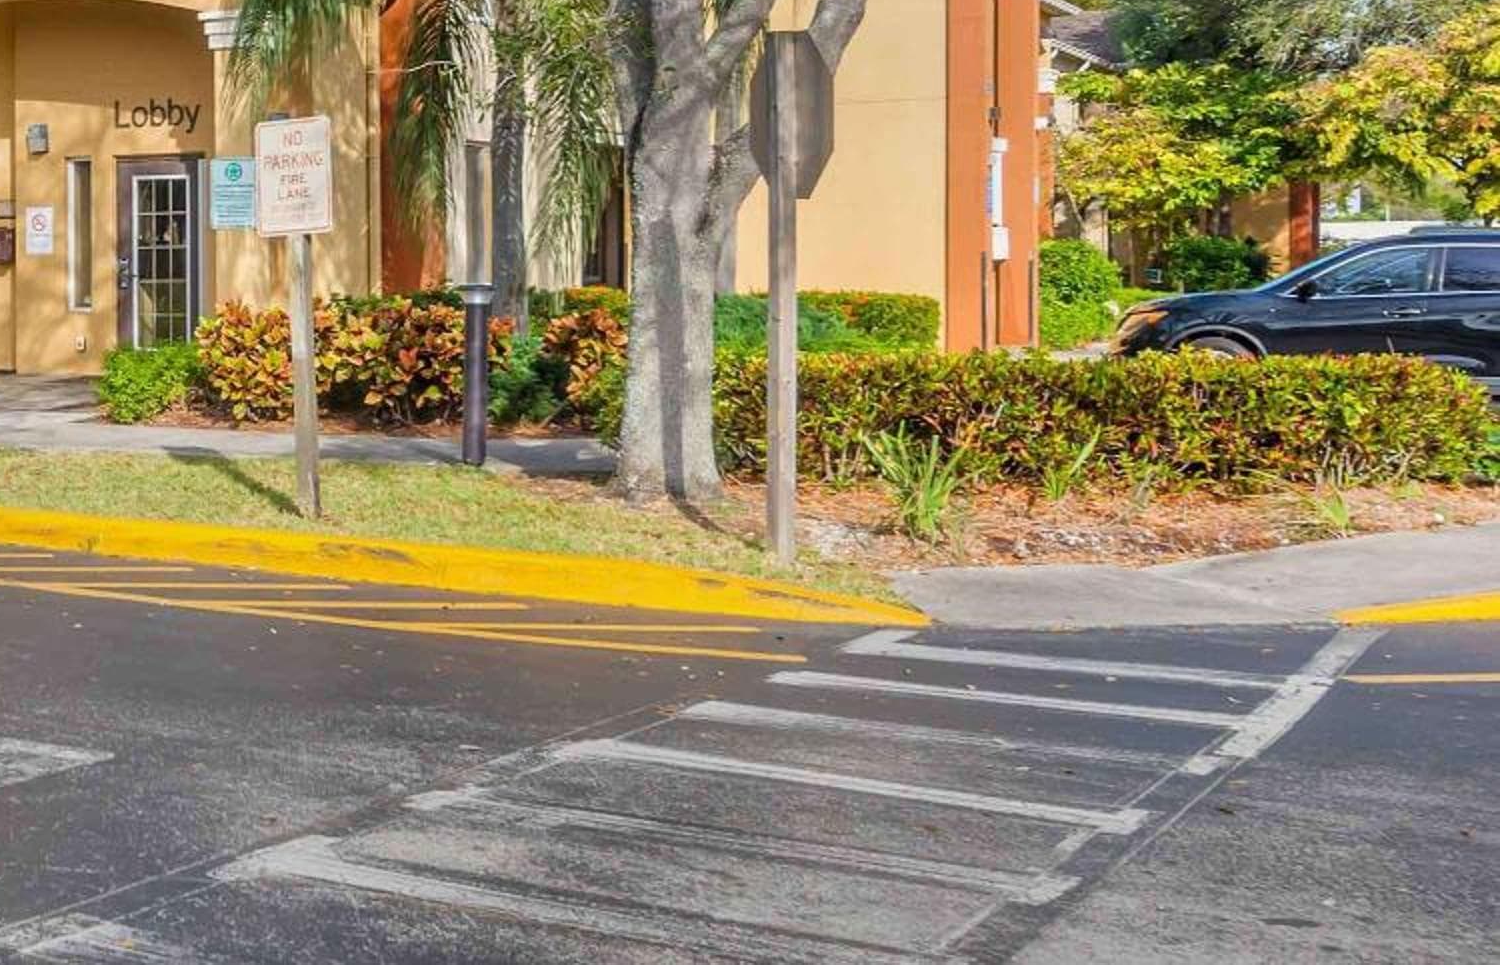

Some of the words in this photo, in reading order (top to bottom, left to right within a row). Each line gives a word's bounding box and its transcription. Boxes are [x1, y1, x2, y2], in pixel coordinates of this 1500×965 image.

[114, 98, 201, 134] Lobby
[283, 130, 303, 147] NO
[264, 152, 324, 170] PARKING
[280, 173, 308, 185] FIRE
[277, 187, 311, 200] LANE
